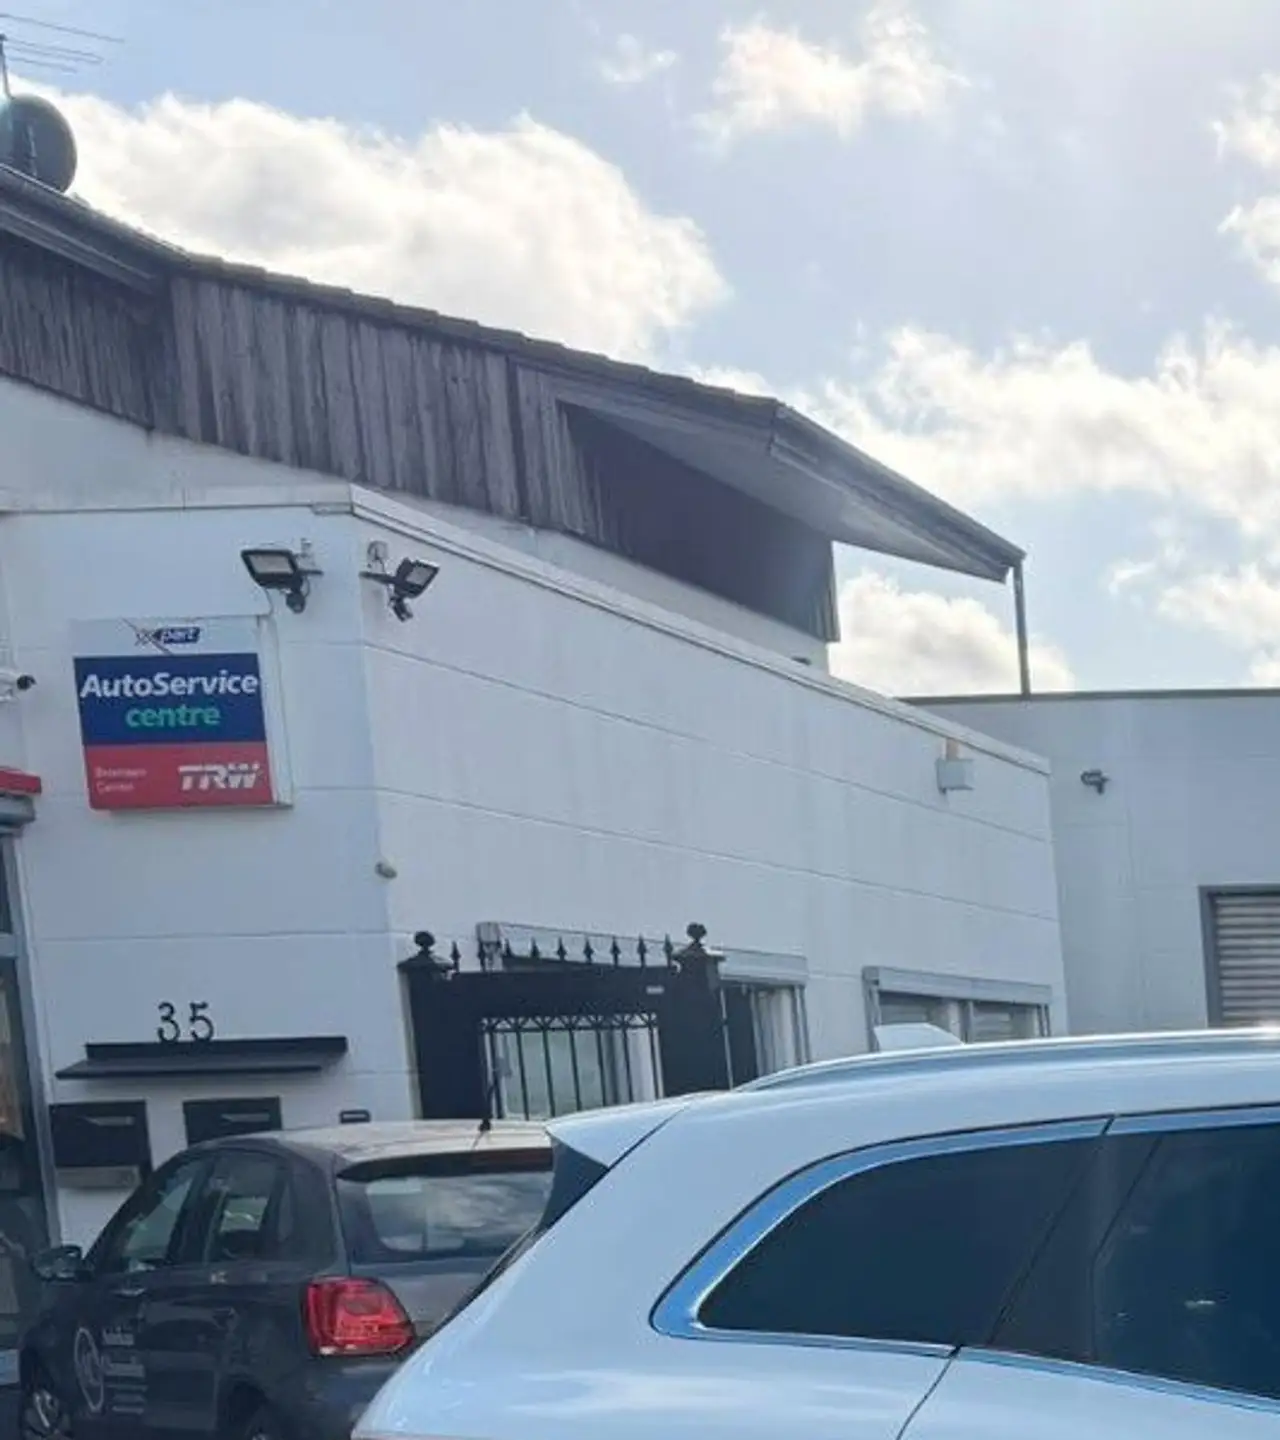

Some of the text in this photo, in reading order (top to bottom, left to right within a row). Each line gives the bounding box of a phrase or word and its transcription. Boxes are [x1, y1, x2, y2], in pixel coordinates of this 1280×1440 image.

[79, 669, 259, 698] AutoService
[124, 704, 222, 728] centre
[178, 762, 261, 791] TRW
[157, 1001, 214, 1043] 35
